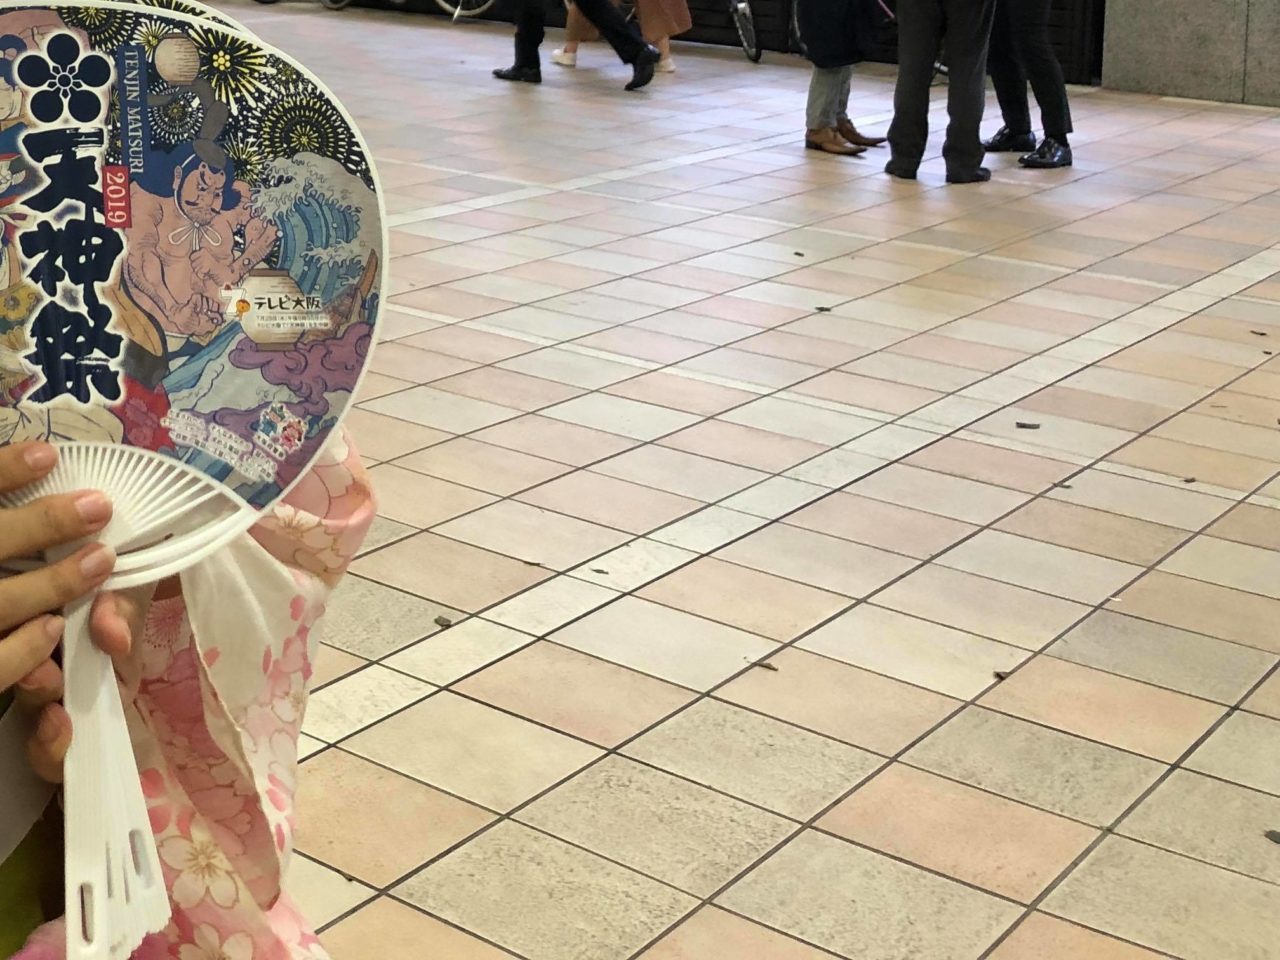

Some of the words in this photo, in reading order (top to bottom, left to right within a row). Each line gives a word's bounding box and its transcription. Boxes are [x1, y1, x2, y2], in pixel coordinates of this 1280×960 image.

[124, 50, 140, 102] TENJIN
[127, 106, 144, 174] MATSURI
[106, 172, 127, 223] 2019
[19, 127, 124, 404] 天神祭
[253, 294, 321, 310] テレビ大阪
